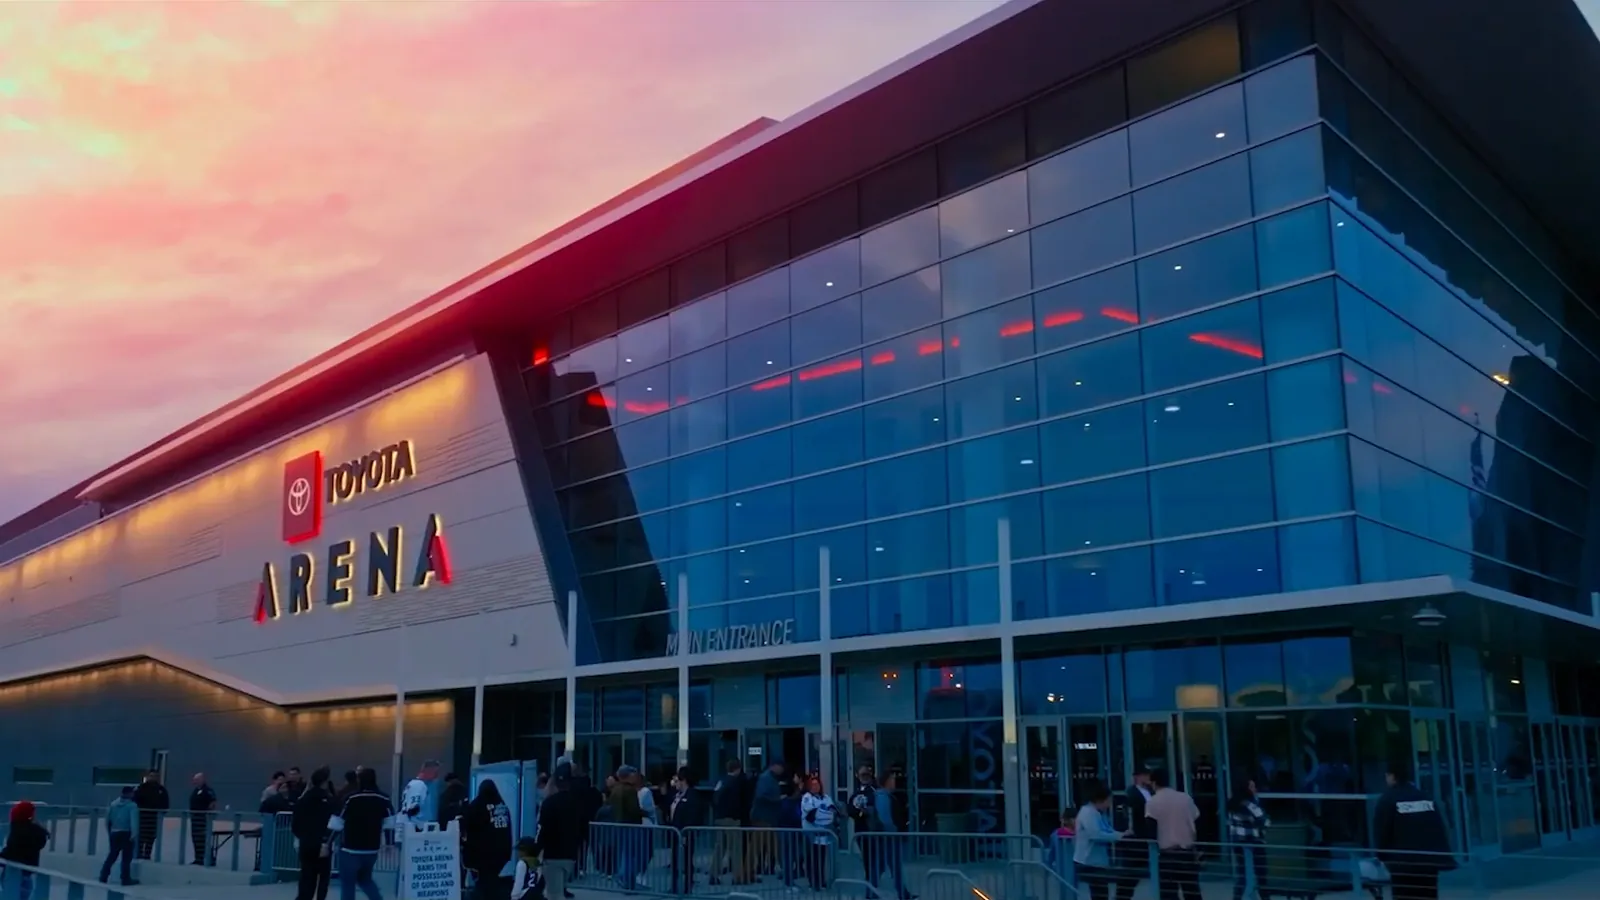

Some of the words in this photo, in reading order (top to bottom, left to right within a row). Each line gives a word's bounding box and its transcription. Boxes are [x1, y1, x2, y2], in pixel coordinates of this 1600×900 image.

[325, 440, 416, 505] TOYOTA
[253, 513, 452, 624] ARENA
[665, 629, 703, 657] MIN
[706, 618, 795, 651] ENTRANCE
[411, 855, 433, 863] TOYOTA
[434, 854, 454, 862] ARENA
[417, 864, 435, 872] BANS
[412, 871, 453, 880] POSSESSION
[411, 881, 420, 890] OF
[421, 880, 439, 889] GUNS
[440, 879, 455, 888] AND
[417, 889, 449, 898] WEAPONS
